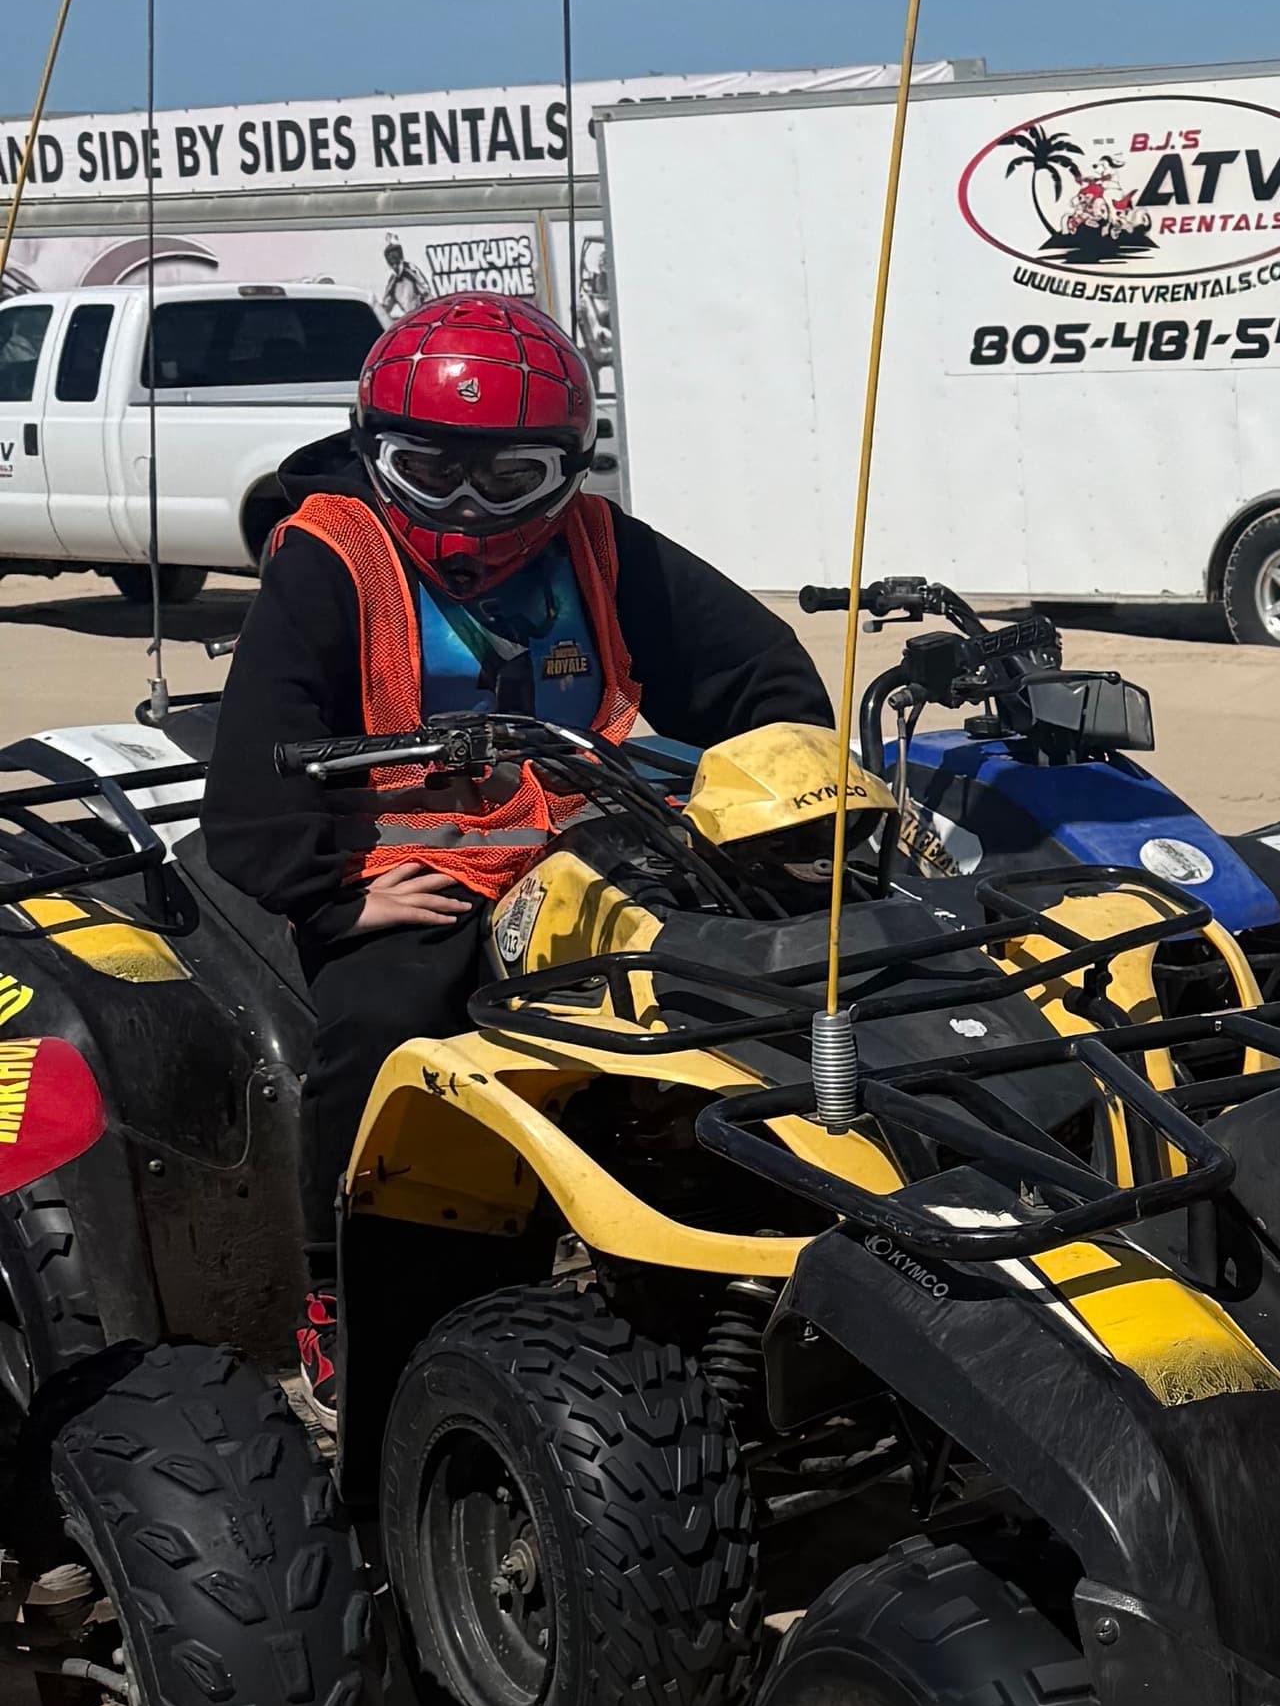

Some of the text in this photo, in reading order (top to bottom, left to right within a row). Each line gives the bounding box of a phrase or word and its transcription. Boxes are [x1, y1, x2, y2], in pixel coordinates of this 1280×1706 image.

[77, 129, 162, 185] SIDE
[175, 124, 224, 177] BY
[240, 116, 356, 175] SIDES
[371, 102, 568, 169] RENTALS
[426, 236, 534, 273] WALK-UPS
[433, 266, 537, 296] WELCOME
[546, 657, 588, 676] ROYALE
[888, 1250, 949, 1297] KYMCO
